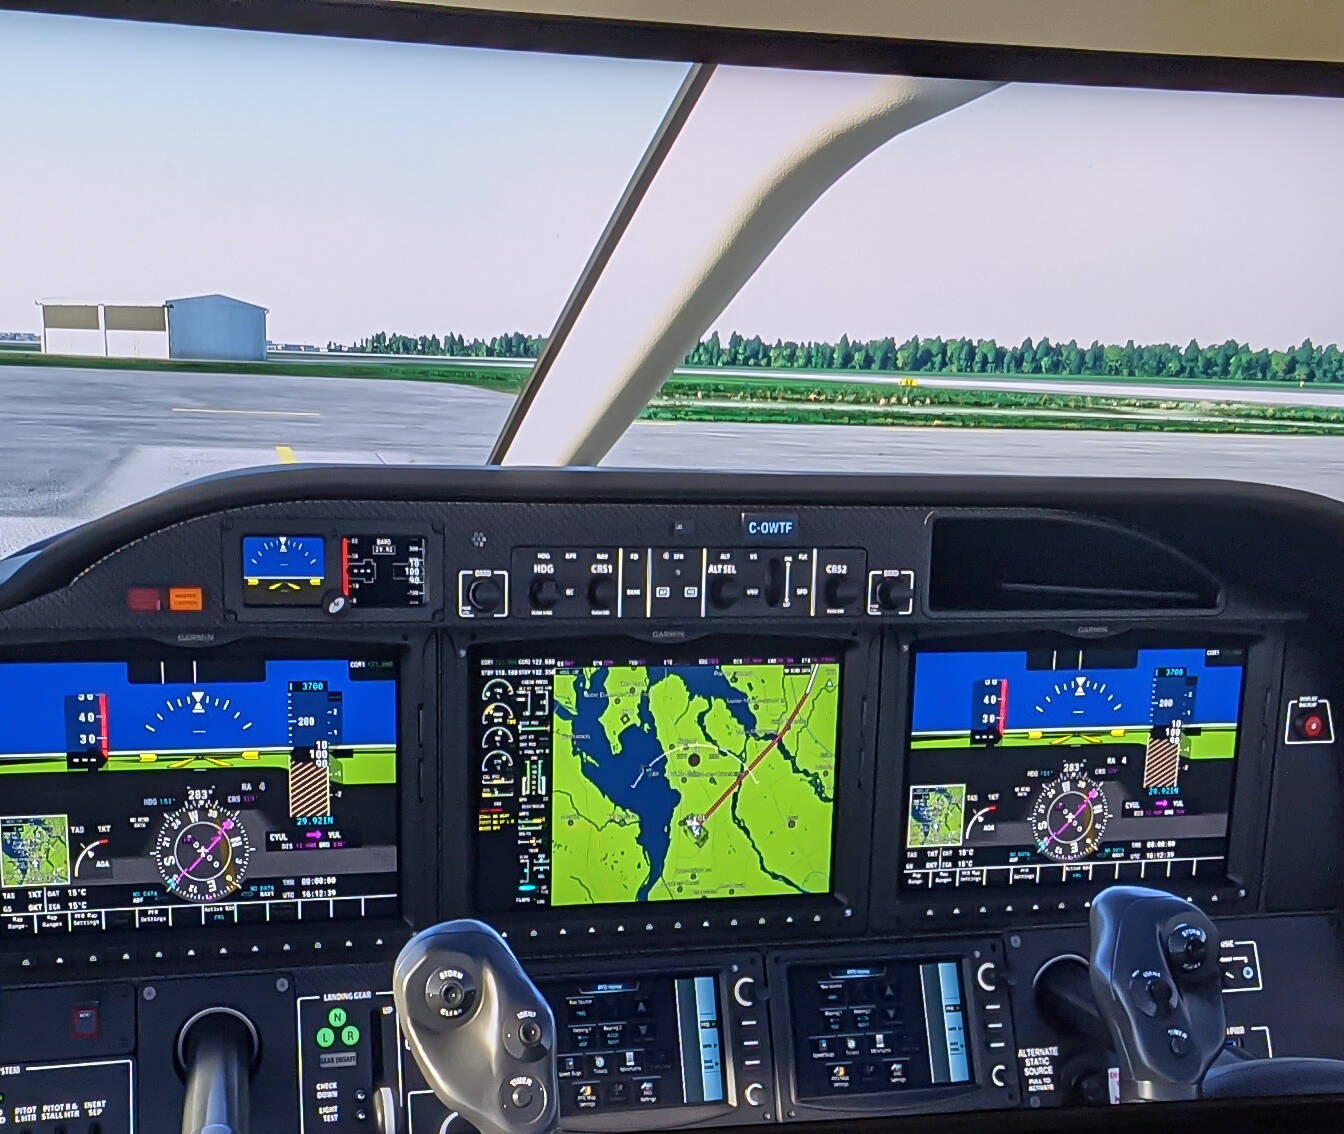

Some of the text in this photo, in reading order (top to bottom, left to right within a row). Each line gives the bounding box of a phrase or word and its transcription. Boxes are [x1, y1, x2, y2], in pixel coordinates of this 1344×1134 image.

[749, 521, 793, 535] C-OWTF
[533, 564, 554, 574] HDG
[302, 682, 323, 691] 3700
[79, 712, 95, 722] 40
[1018, 1047, 1058, 1057] ALTERNATE
[1025, 1057, 1049, 1066] STATIC
[1024, 1066, 1053, 1076] SOURCE
[316, 1082, 337, 1090] CHECK
